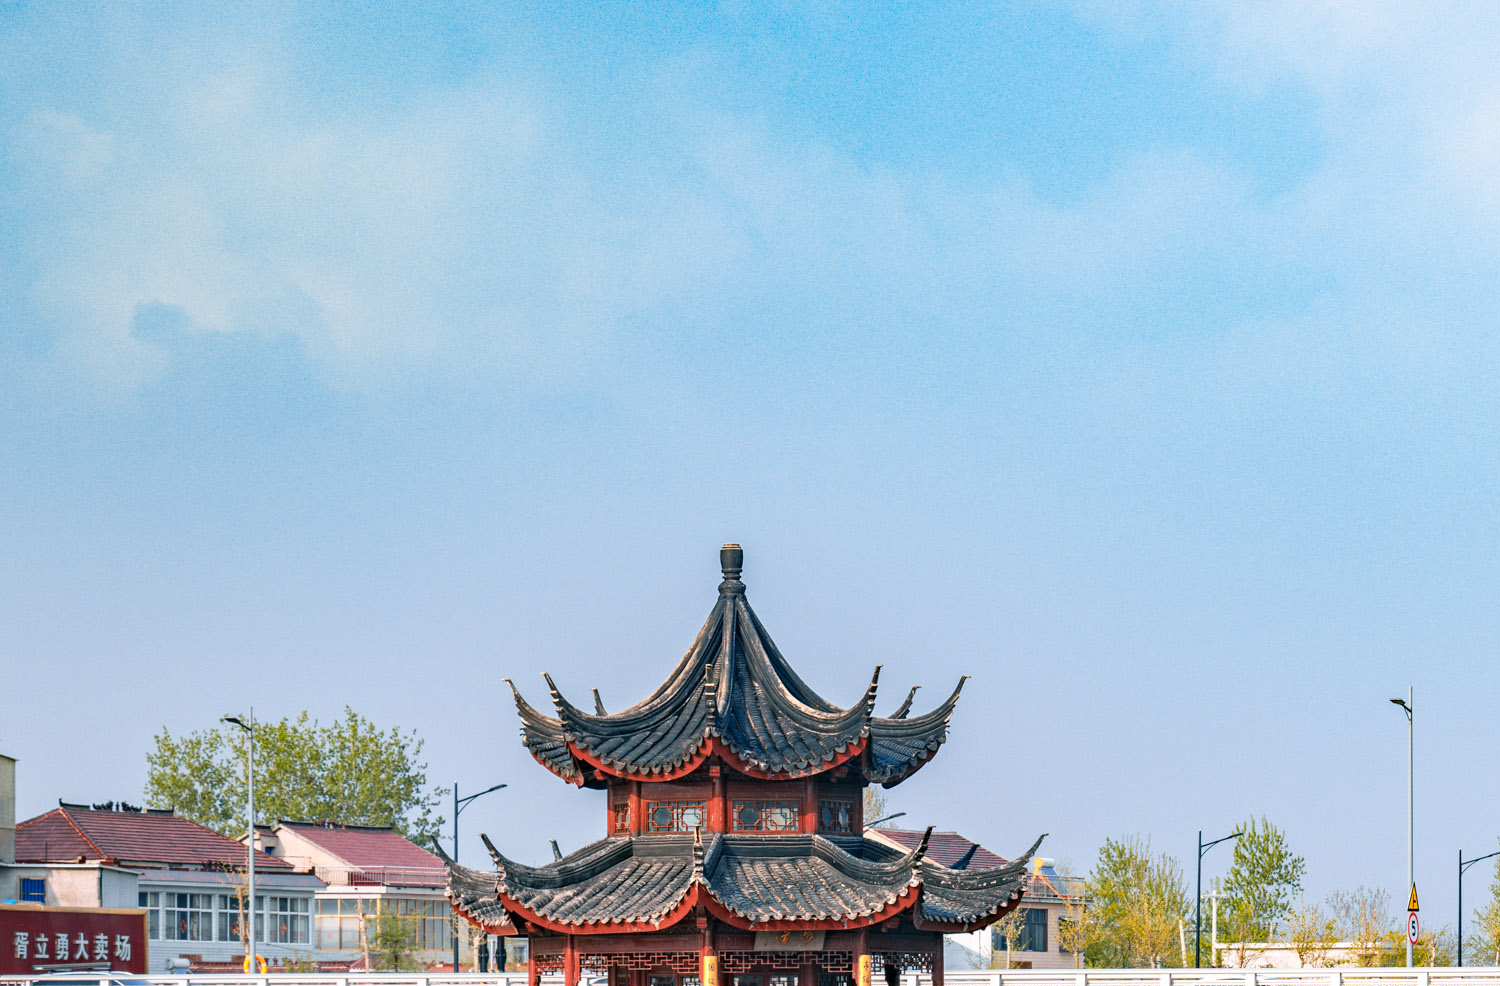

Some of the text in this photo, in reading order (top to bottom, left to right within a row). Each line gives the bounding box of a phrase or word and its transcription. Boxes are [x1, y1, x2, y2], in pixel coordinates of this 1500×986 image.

[14, 931, 131, 961] 胥立勇大卖场
